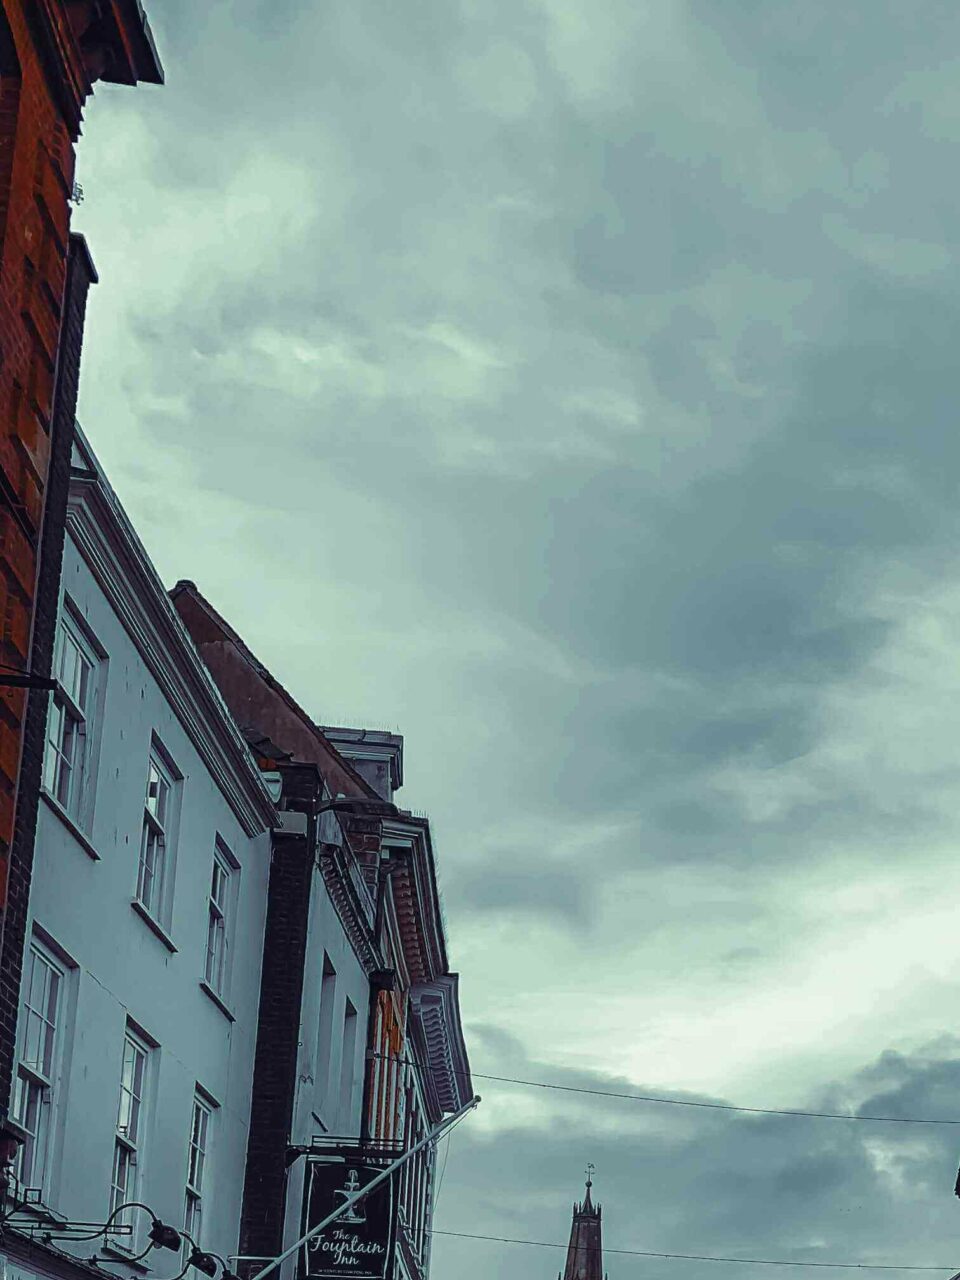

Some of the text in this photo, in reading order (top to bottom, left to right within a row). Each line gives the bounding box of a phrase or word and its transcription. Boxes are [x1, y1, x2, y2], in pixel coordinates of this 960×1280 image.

[333, 1230, 350, 1240] The
[310, 1234, 385, 1255] Fountain
[333, 1253, 359, 1266] Inn
